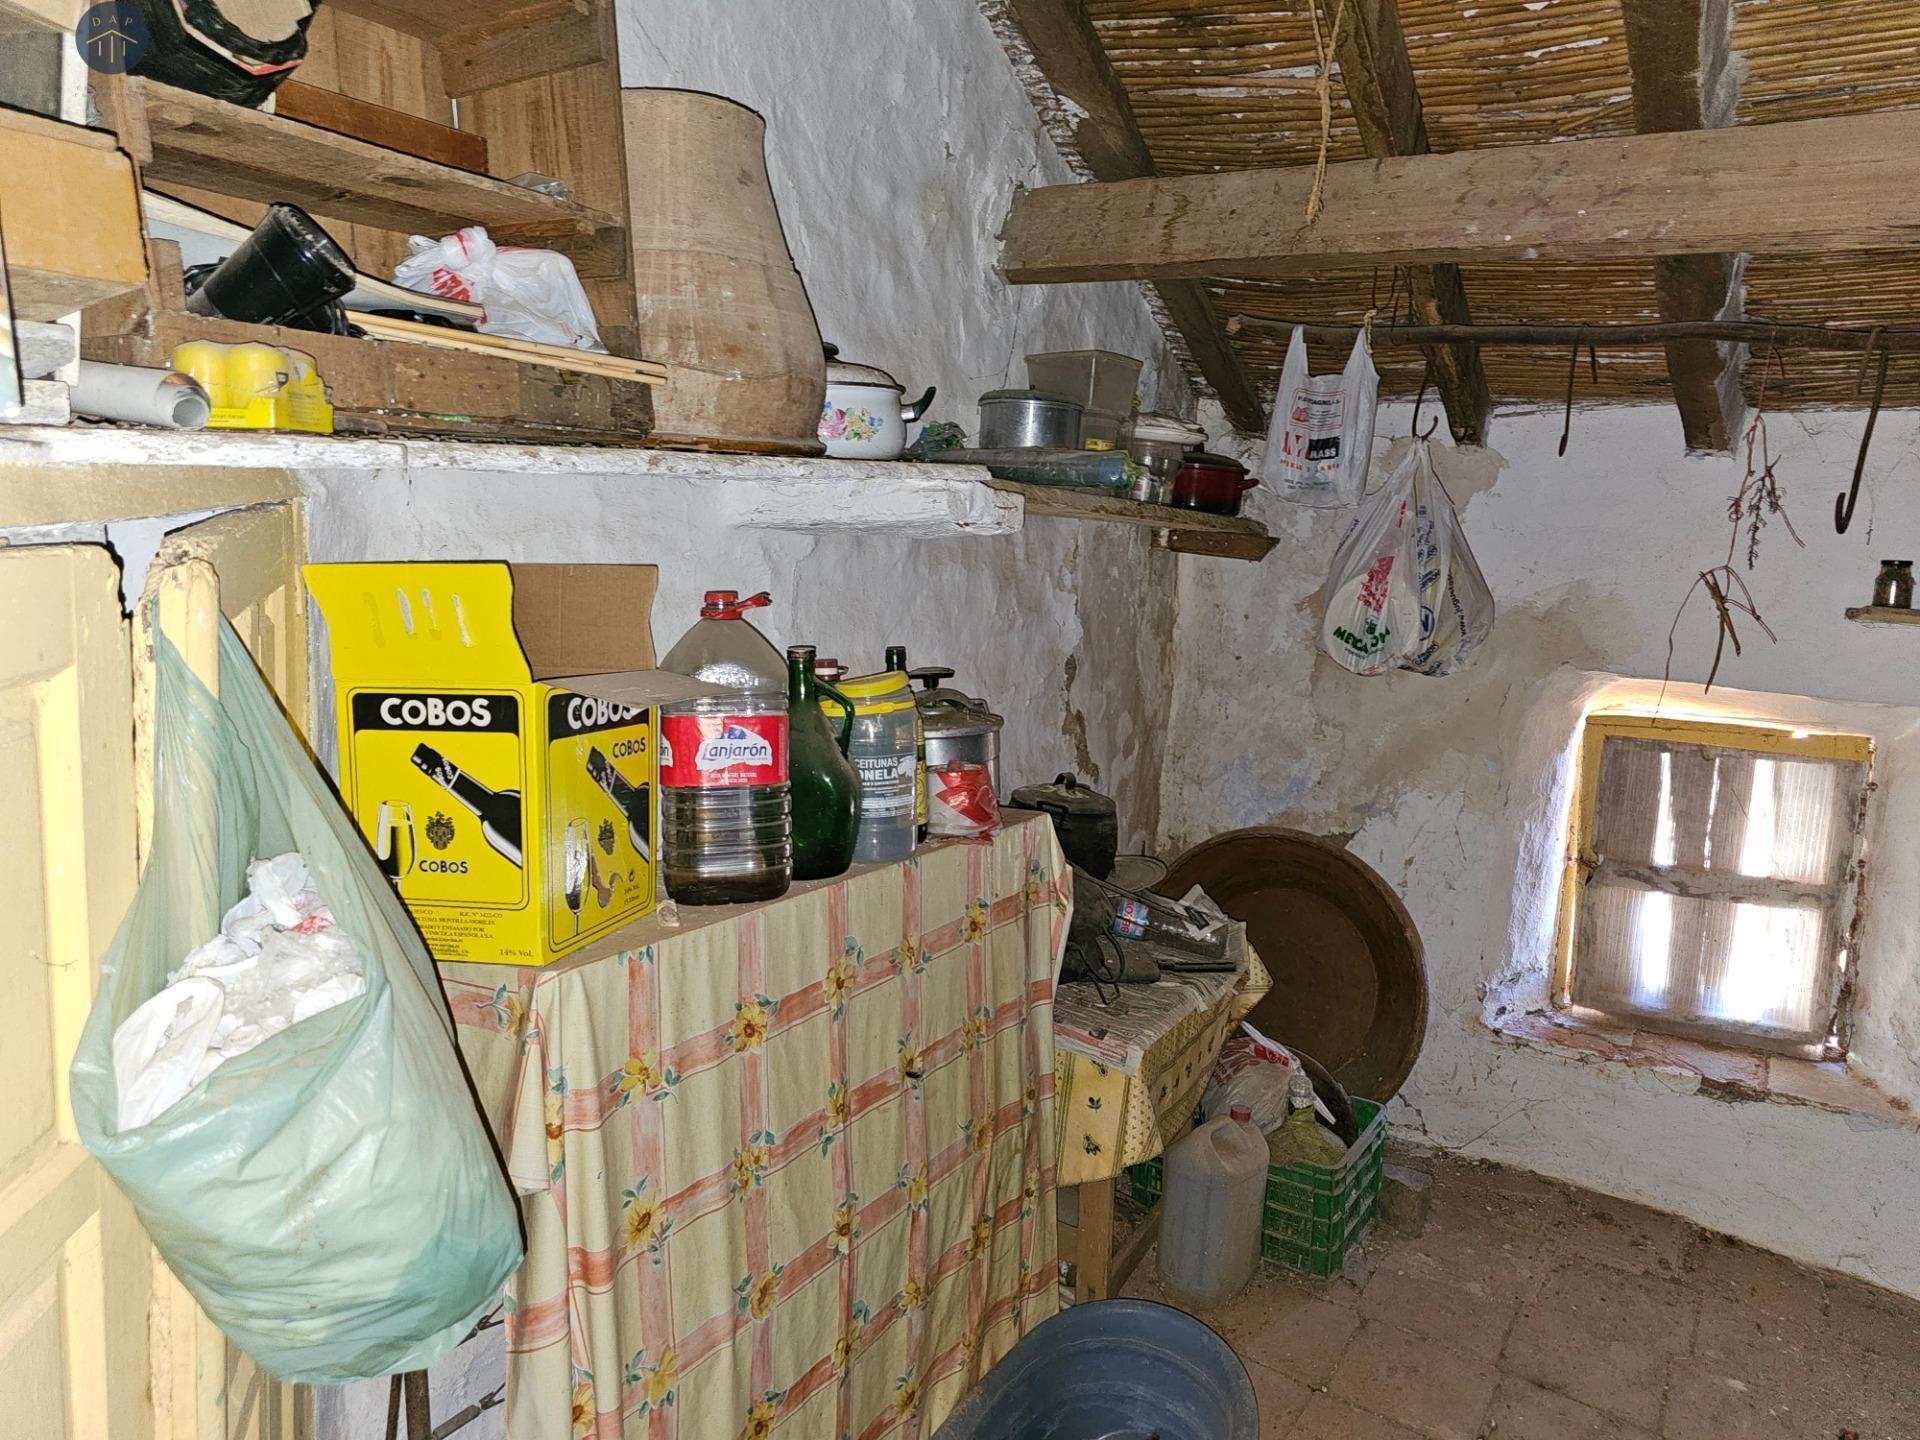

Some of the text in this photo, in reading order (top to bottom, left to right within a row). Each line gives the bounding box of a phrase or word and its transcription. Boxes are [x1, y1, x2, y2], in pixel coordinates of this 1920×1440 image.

[380, 697, 492, 727] COBOS
[612, 736, 647, 759] COBOS
[418, 859, 469, 875] COBOS
